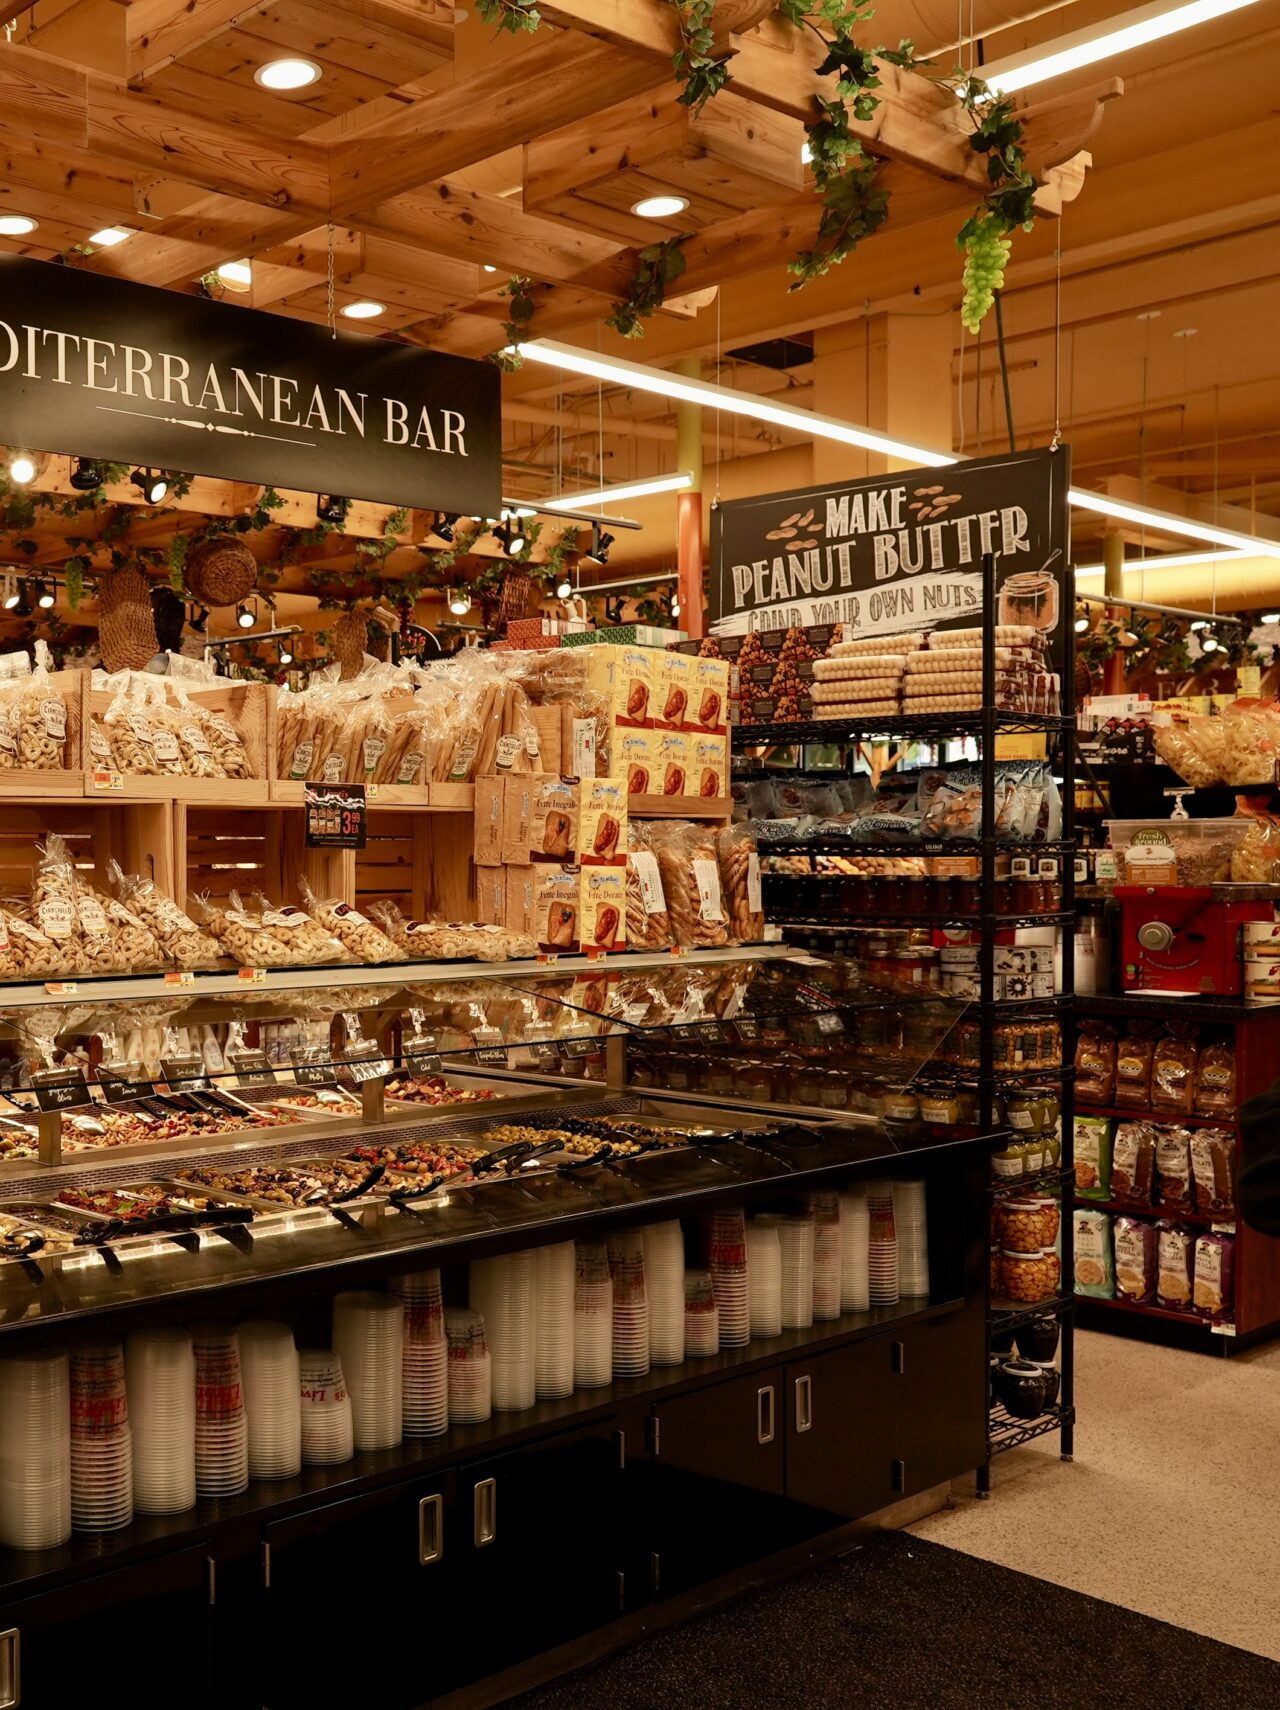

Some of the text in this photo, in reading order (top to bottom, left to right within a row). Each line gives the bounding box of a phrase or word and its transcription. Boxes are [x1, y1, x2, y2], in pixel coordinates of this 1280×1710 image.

[383, 398, 469, 457] BAR
[825, 486, 908, 540] MAKE
[731, 505, 1031, 608] PEANUT BUTTER
[811, 595, 862, 628] YOUR
[870, 591, 915, 622] OWN
[923, 584, 977, 611] NUTS
[351, 824, 359, 834] EA
[1138, 831, 1163, 840] fresh
